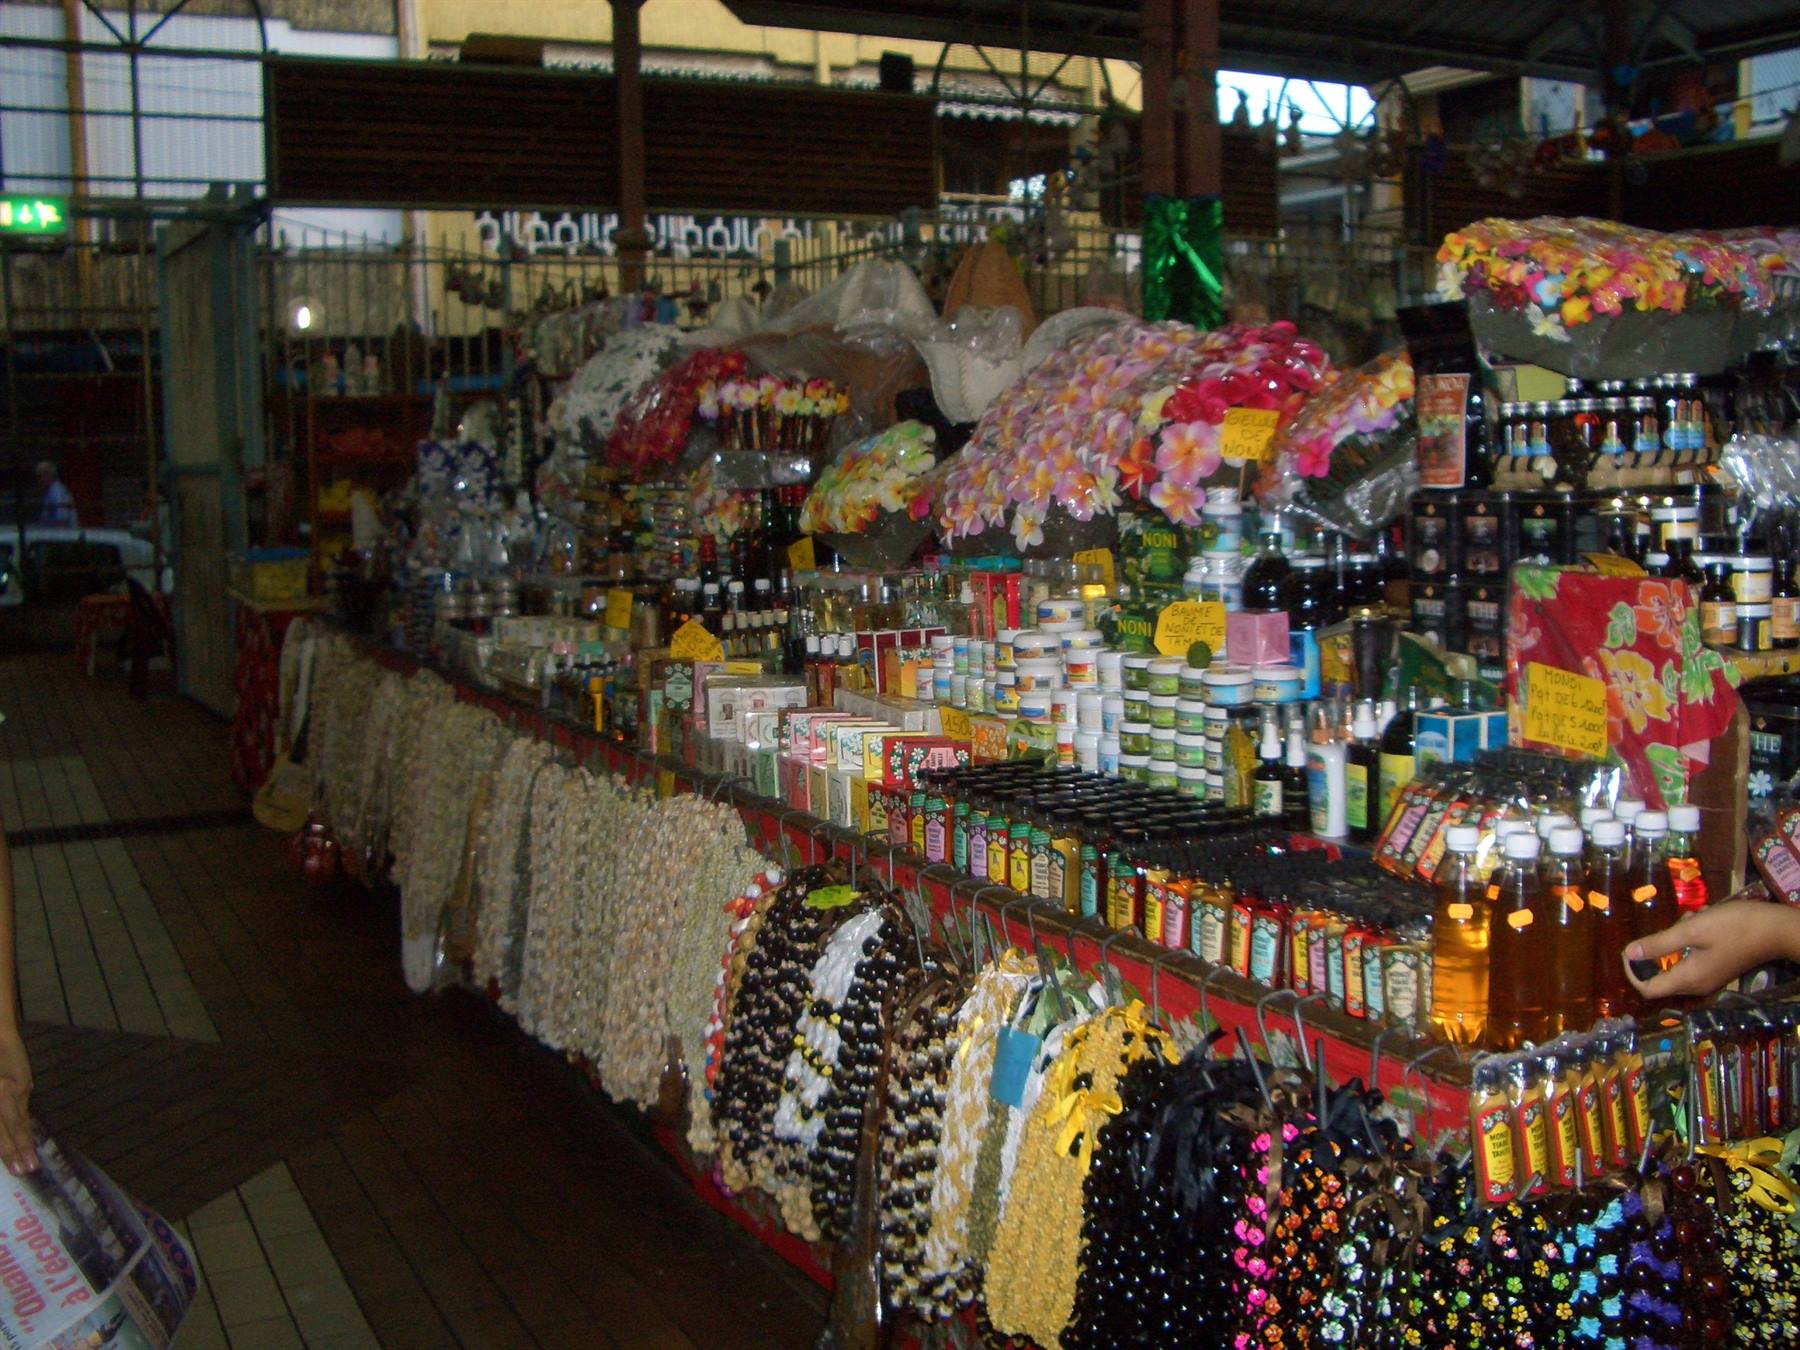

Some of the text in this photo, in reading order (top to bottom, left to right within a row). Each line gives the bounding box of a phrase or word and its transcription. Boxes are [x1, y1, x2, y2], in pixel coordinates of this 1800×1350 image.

[1142, 531, 1178, 549] NONI
[1171, 605, 1216, 618] BAUME
[1117, 619, 1152, 638] NONI
[1750, 732, 1781, 754] HE
